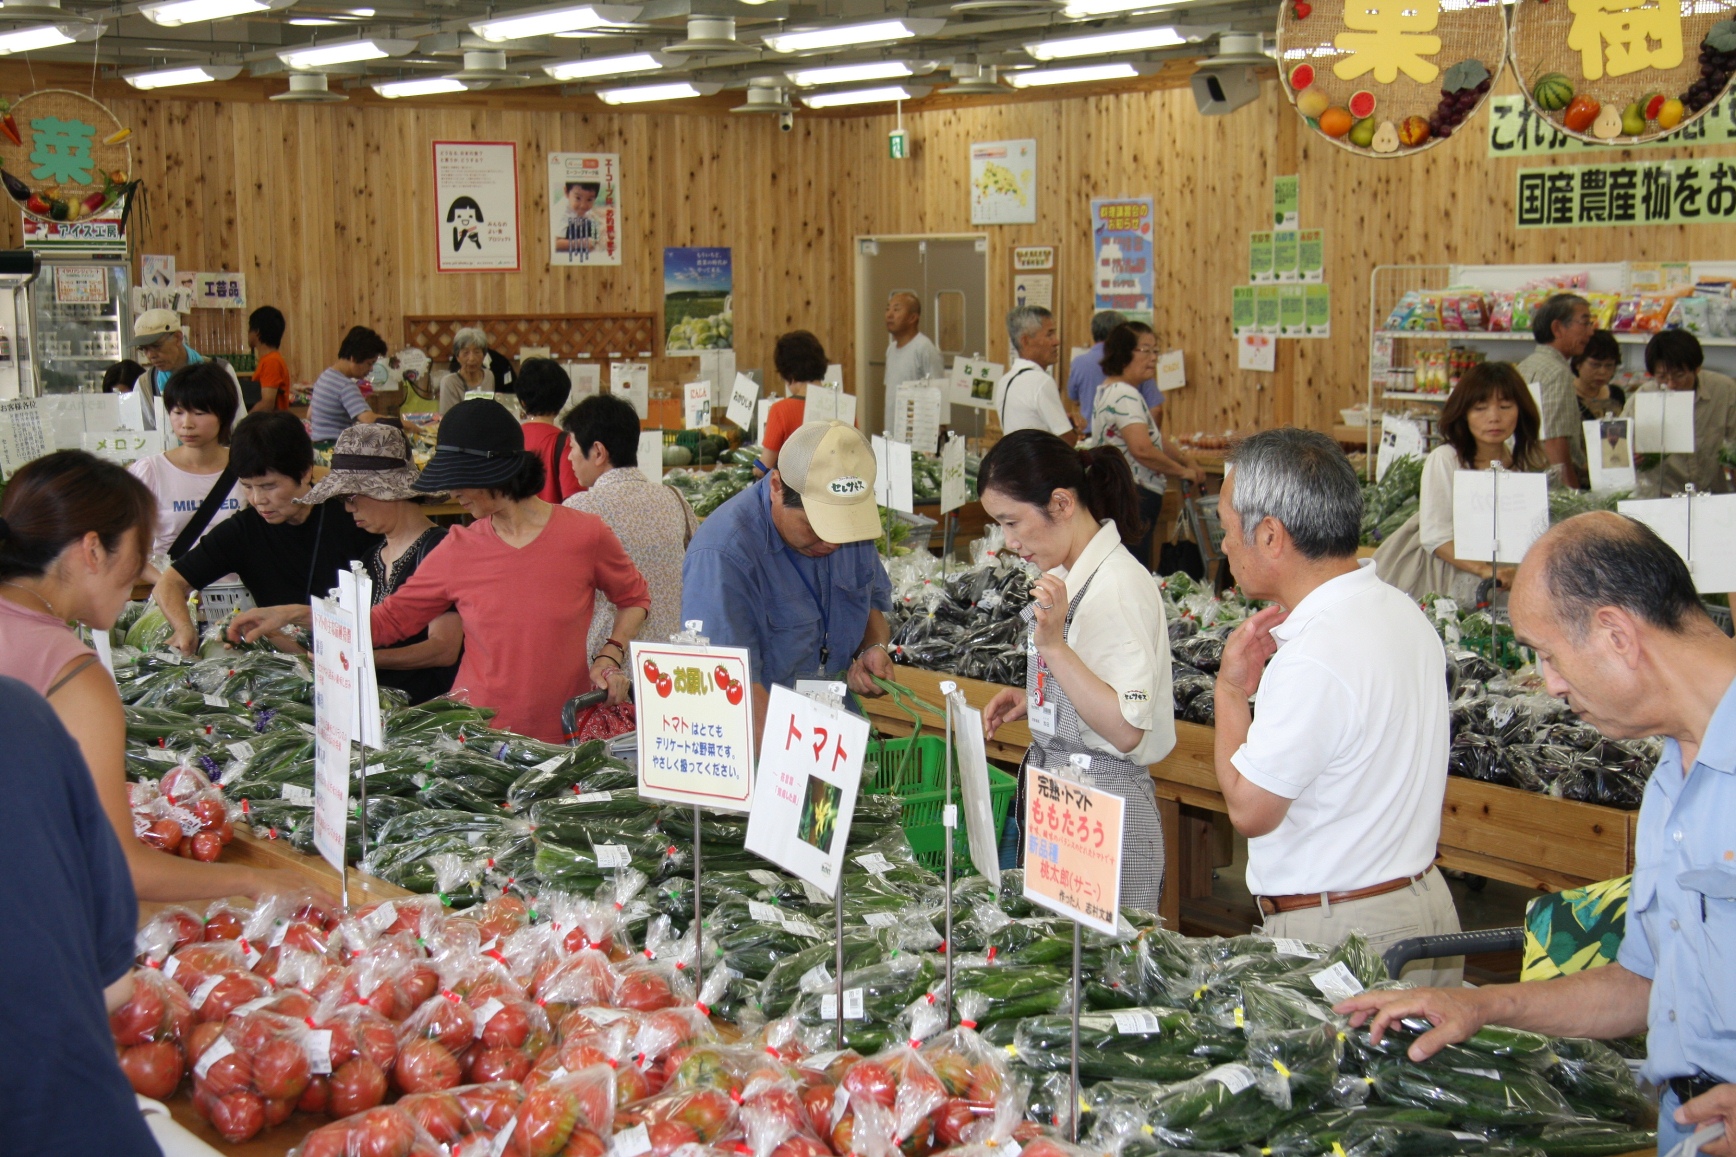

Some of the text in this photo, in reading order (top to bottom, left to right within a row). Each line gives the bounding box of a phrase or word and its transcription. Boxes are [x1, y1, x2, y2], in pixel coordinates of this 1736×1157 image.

[29, 115, 97, 186] 菜
[1518, 163, 1736, 226] 国産農産物をお
[58, 223, 118, 238] アイス工房
[1108, 218, 1140, 230] お知らせ
[204, 280, 239, 298] 工芸品
[964, 364, 990, 379] ねぎ
[1, 401, 37, 412] お客様各位
[96, 438, 147, 451] メロン
[831, 480, 865, 493] セレサモス
[673, 666, 714, 696] お願い
[1124, 693, 1148, 701] セレサモス
[655, 737, 736, 760] デリケートな野菜です。
[785, 713, 848, 773] トマト
[652, 755, 740, 780] やさしく扱ってください。
[1031, 798, 1105, 848] ももたろう
[1028, 835, 1060, 864] 新品種
[1059, 889, 1081, 910] 作った人
